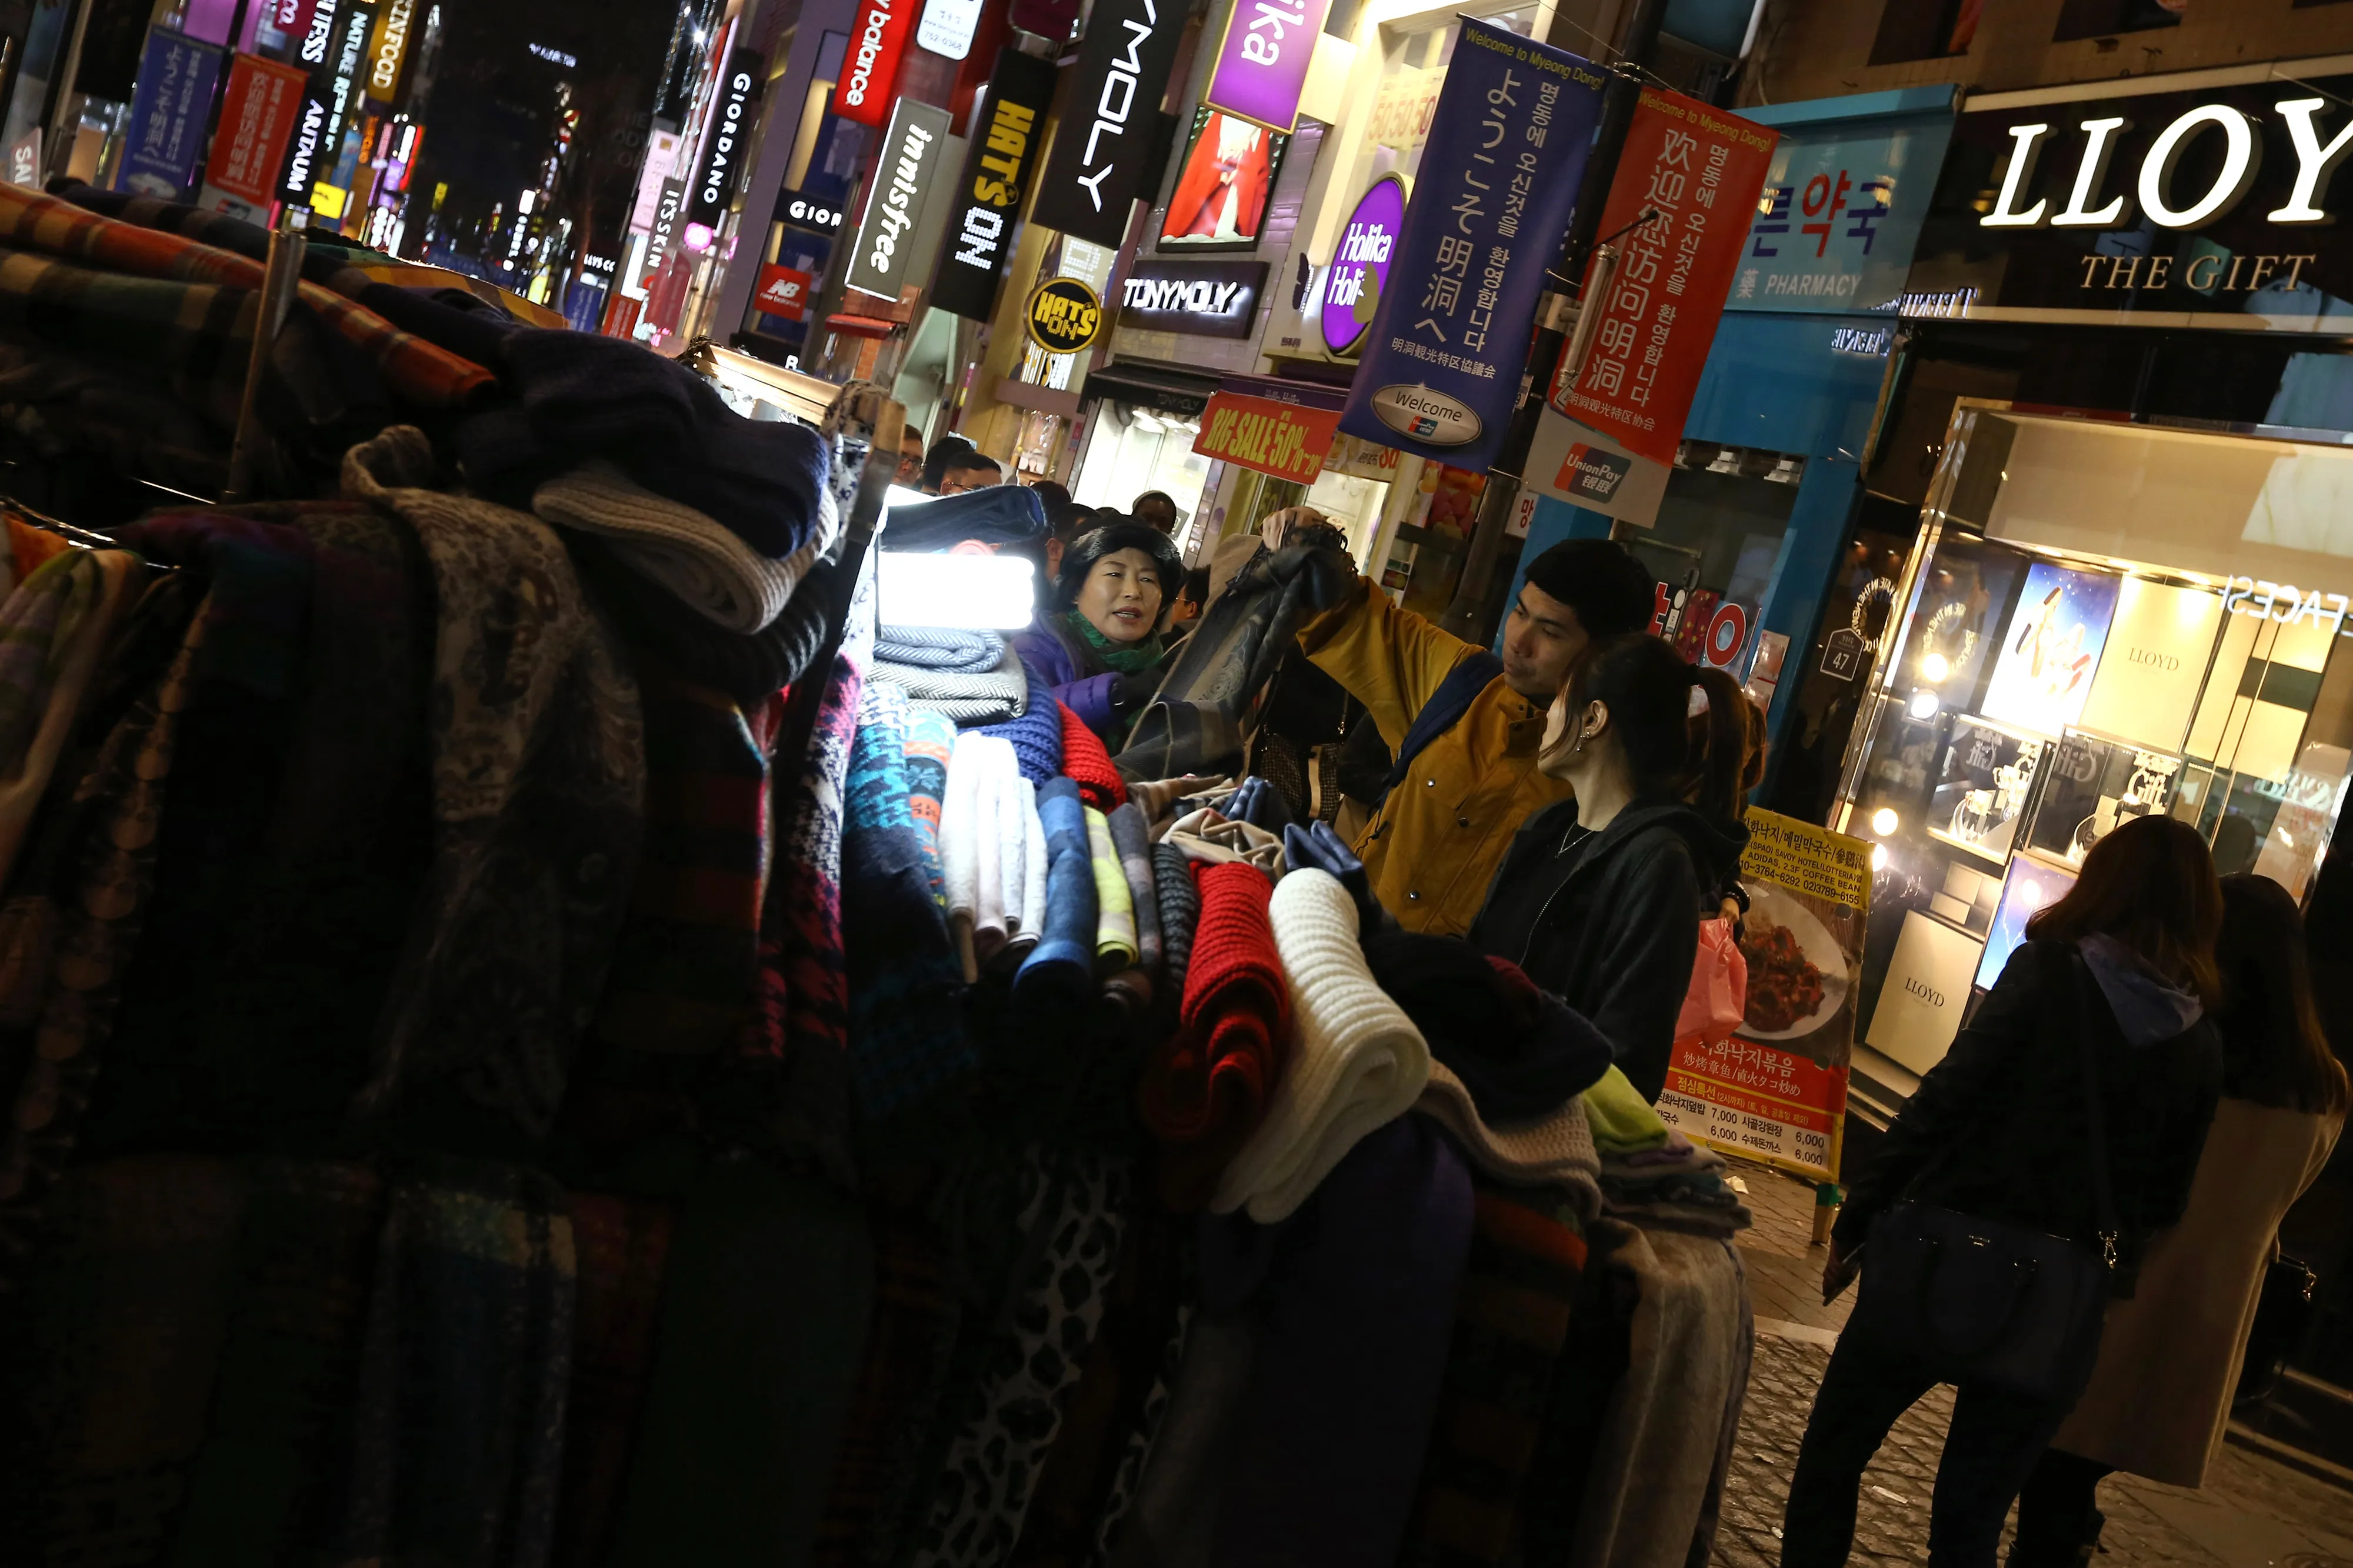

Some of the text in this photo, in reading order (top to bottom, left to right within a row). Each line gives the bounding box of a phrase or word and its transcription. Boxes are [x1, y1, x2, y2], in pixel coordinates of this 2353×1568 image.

[338, 11, 368, 76] NATURE
[845, 9, 894, 108] balance
[1465, 26, 1605, 91] Welcome to Myeong Dong!
[703, 72, 751, 205] GIORDANO
[1639, 91, 1771, 152] Welcome to Myeong Dong!
[286, 98, 324, 192] ARITAUM
[869, 123, 934, 275] innisfree
[1415, 68, 1522, 343] ようこそ明洞へ
[1463, 81, 1560, 353] 명동에 오신것을 환영합니다
[954, 206, 1004, 271] ON
[1341, 222, 1393, 263] Holika
[1585, 128, 1698, 397] 欢迎您访问明洞
[1630, 144, 1729, 408] 명동에 오신것을 환영합니다
[2080, 253, 2317, 291] THE GIFT
[1122, 276, 1240, 315] TONYMOLY
[1765, 273, 1863, 296] PHARMACY
[1046, 315, 1079, 341] ON
[1391, 336, 1497, 379] 明洞観光特区協議会
[1395, 391, 1462, 422] Welcome
[1202, 407, 1237, 454] BIG
[1235, 412, 1275, 465] SALE
[1567, 453, 1622, 486] UnionPay
[1581, 473, 1612, 494] 银联
[1832, 652, 1850, 670] 47
[2128, 648, 2180, 672] LLOYD
[1775, 848, 1796, 863] SAVOY
[1802, 869, 1835, 885] COFFEE
[1837, 879, 1861, 893] BEAN
[1803, 879, 1860, 905] 02)3789-6155
[1905, 977, 1945, 1008] LLOYD
[1677, 1076, 1716, 1100] 점심특선
[1717, 1091, 1746, 1109] (2시까지)
[1710, 1125, 1737, 1142] 6,000
[1741, 1133, 1782, 1154] 수제돈까스
[1795, 1149, 1823, 1166] 6,000
[1711, 1107, 1737, 1124] 7,000
[1741, 1116, 1782, 1137] 시골강된장
[1795, 1130, 1824, 1148] 6,000
